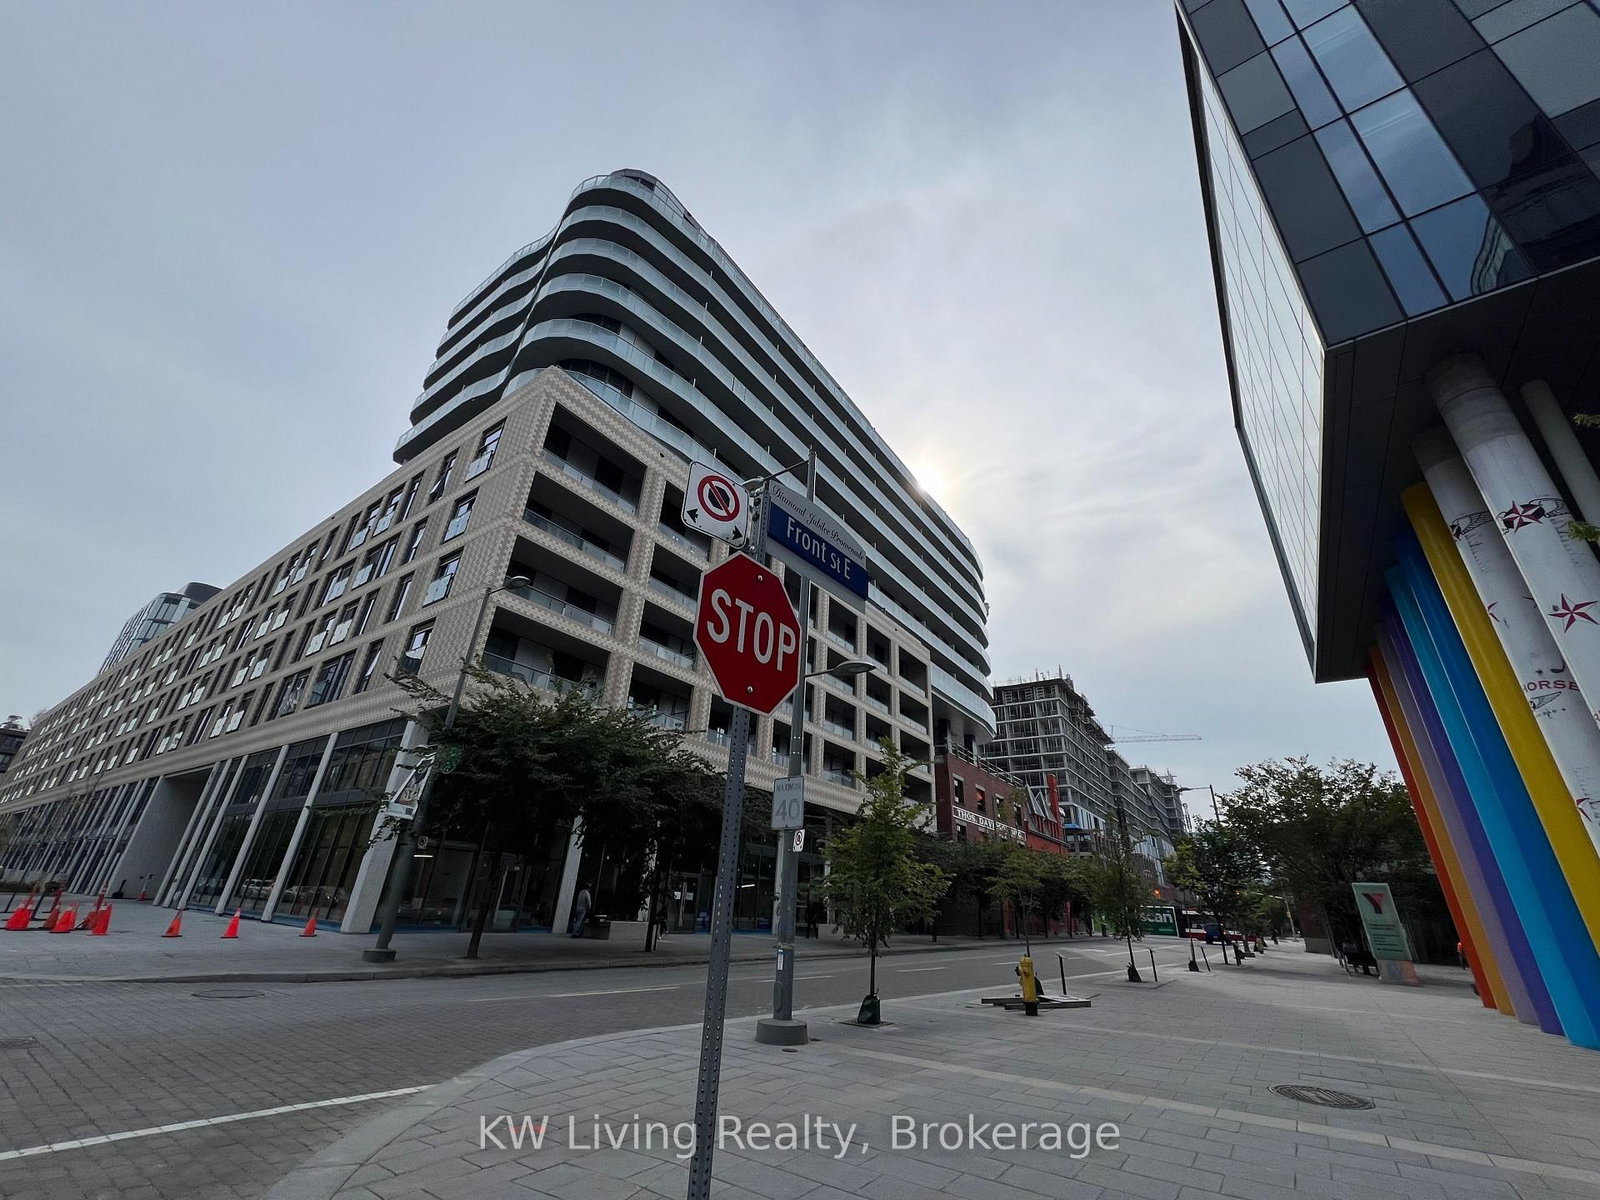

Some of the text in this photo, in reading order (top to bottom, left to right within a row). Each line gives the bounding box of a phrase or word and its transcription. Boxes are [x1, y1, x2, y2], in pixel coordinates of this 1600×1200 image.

[772, 483, 807, 516] Diamond
[806, 512, 830, 536] Jubilee
[786, 516, 851, 580] Front St E
[707, 588, 796, 671] STOP
[775, 798, 800, 821] 40
[957, 808, 978, 823] THOS.
